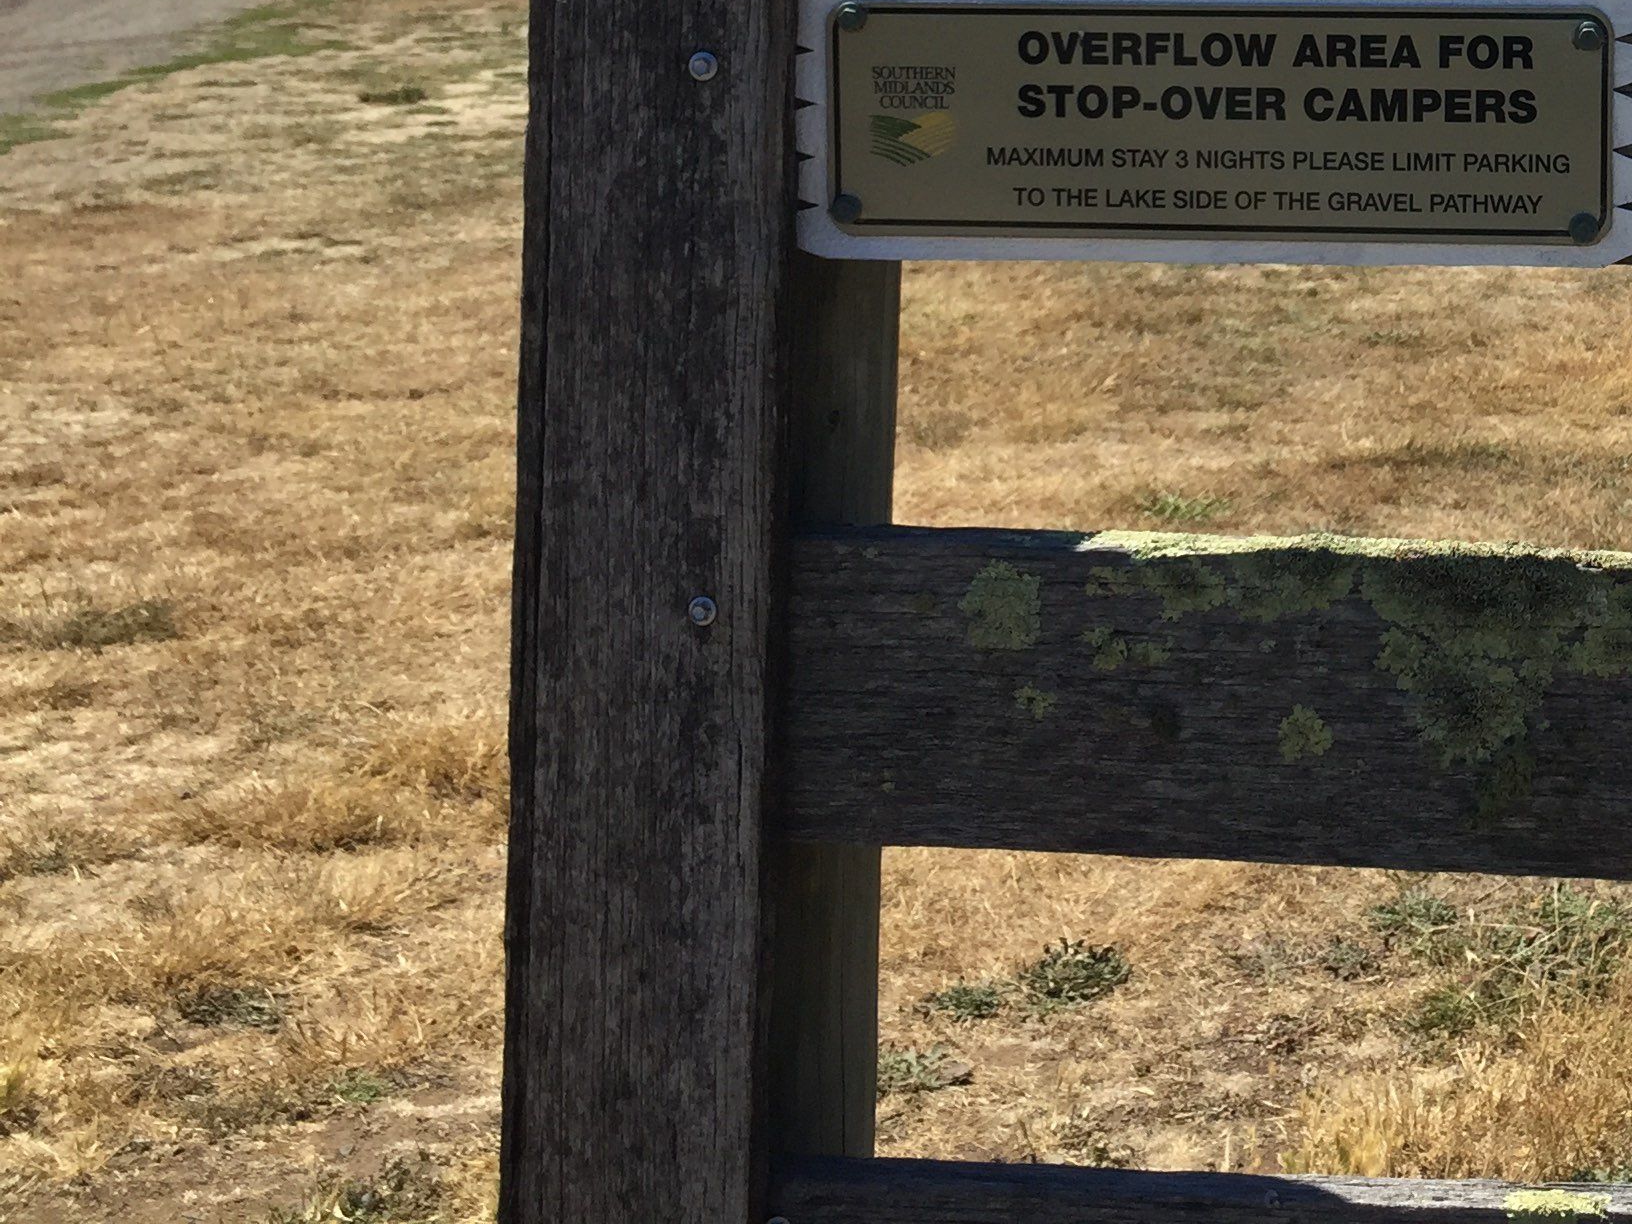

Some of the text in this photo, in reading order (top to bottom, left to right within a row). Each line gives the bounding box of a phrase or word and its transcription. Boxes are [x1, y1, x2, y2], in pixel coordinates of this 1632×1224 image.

[1017, 30, 1534, 70] OVERFLOW AREA FOR
[872, 65, 956, 80] SOUTHERN
[873, 80, 956, 95] MIDLANDS
[879, 95, 950, 110] COUNCIL
[1017, 84, 1538, 124] STOP-OVER CAMPERS
[986, 146, 1570, 175] MAXIMUM STAY 3 NIGHTS PLEASE LIMIT PARKING
[1013, 187, 1543, 215] TO THE LAKE SIDE OF THE GRAVEL PATHWAY
